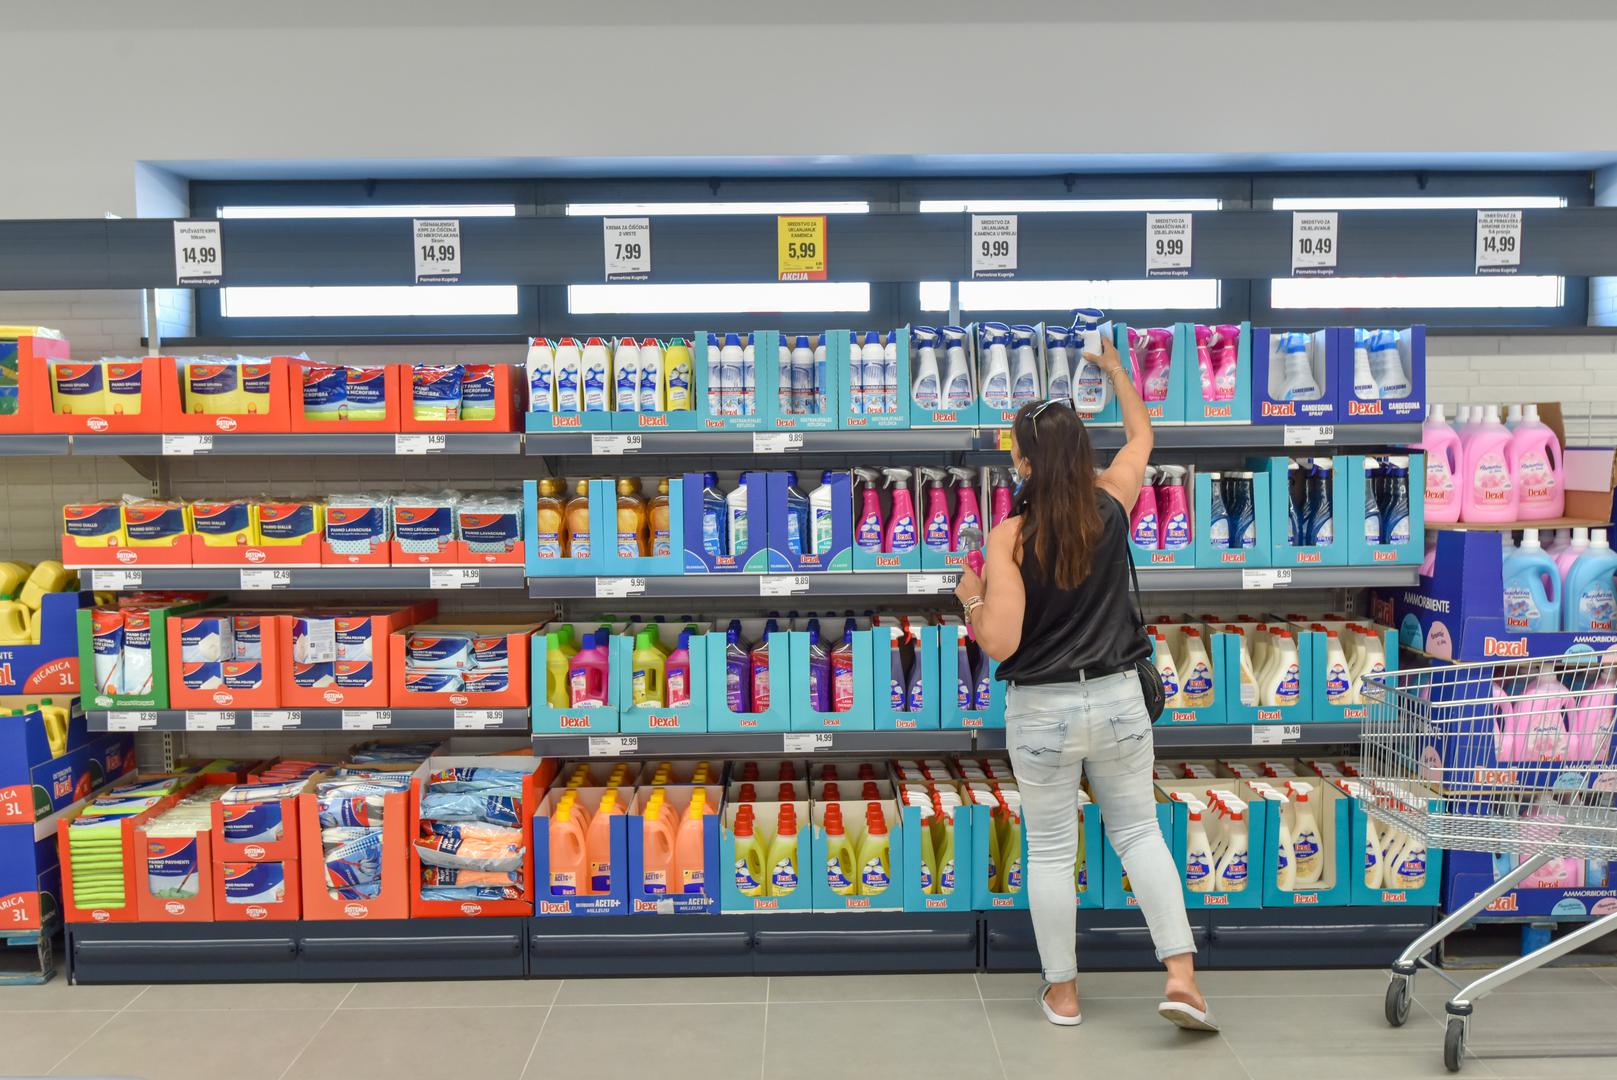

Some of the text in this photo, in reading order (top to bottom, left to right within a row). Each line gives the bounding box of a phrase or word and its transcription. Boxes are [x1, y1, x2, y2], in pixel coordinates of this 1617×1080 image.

[982, 240, 1009, 259] 9,99
[1156, 239, 1183, 257] 9,99
[1299, 238, 1332, 256] 10,49
[1483, 236, 1515, 254] 14,99
[182, 247, 216, 264] 14,99
[421, 245, 455, 263] 14,99
[615, 243, 642, 261] 7,99
[788, 242, 816, 260] 5,99
[782, 272, 808, 281] AKCIJA
[1205, 405, 1232, 417] Dexal
[1262, 401, 1333, 417] Dexal CANDEGGINA
[1349, 400, 1421, 416] Dexal CANDEGGINA
[552, 414, 581, 427] Dexal
[640, 414, 668, 426] Dexal
[848, 417, 867, 426] Dexal
[933, 412, 957, 421] Dexal
[706, 419, 725, 427] Dexal
[776, 418, 796, 427] Dexal
[1425, 491, 1445, 500] Dexal
[1485, 491, 1504, 500] Dexal
[1528, 489, 1548, 497] Dexal
[716, 556, 736, 565] Dexal
[800, 554, 820, 564] Dexal
[946, 555, 968, 565] Dexal
[1152, 553, 1175, 563] Dexal
[1222, 552, 1246, 562] Dexal
[1298, 552, 1322, 562] Dexal
[1374, 550, 1397, 561] Dexal
[877, 557, 900, 566] Dexal
[1507, 618, 1528, 627] Dexal
[1591, 621, 1612, 629] Dexal
[1485, 637, 1529, 657] Dexal
[32, 661, 71, 685] RICARICA
[60, 673, 75, 686] 3L
[1173, 711, 1196, 722] Dexal
[1258, 710, 1282, 720] Dexal
[560, 716, 590, 728] Dexal
[650, 716, 680, 728] Dexal
[896, 720, 917, 728] Dexal
[963, 718, 983, 727] Dexal
[6, 804, 23, 815] 3L
[1204, 894, 1229, 905] Dexal
[1294, 893, 1319, 904] Dexal
[1382, 891, 1406, 902] Dexal
[541, 900, 621, 914] Dexal ACETO+
[634, 899, 658, 912] Dexa
[754, 899, 779, 909] Dexal
[846, 898, 870, 908] Dexal
[926, 899, 947, 908] Dexal
[993, 898, 1014, 907] Dexal
[13, 909, 29, 921] 3L
